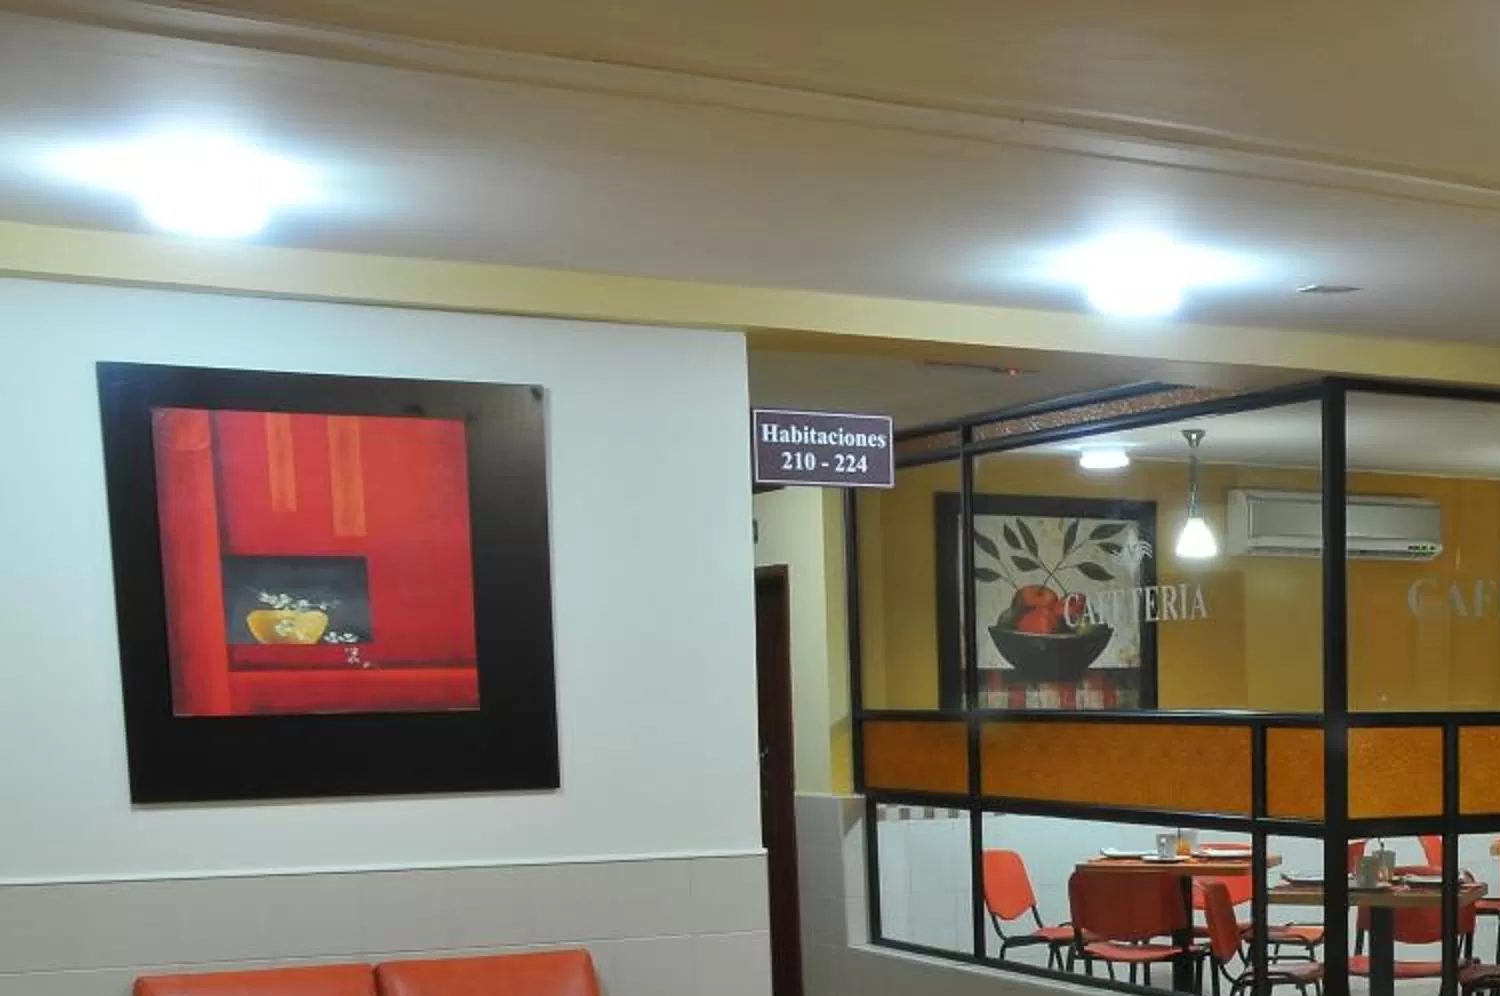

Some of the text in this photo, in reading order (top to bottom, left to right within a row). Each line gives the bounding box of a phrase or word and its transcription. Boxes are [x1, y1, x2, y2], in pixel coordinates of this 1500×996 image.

[761, 423, 887, 448] Habitaciones
[781, 451, 816, 471] 210
[834, 453, 868, 472] 224
